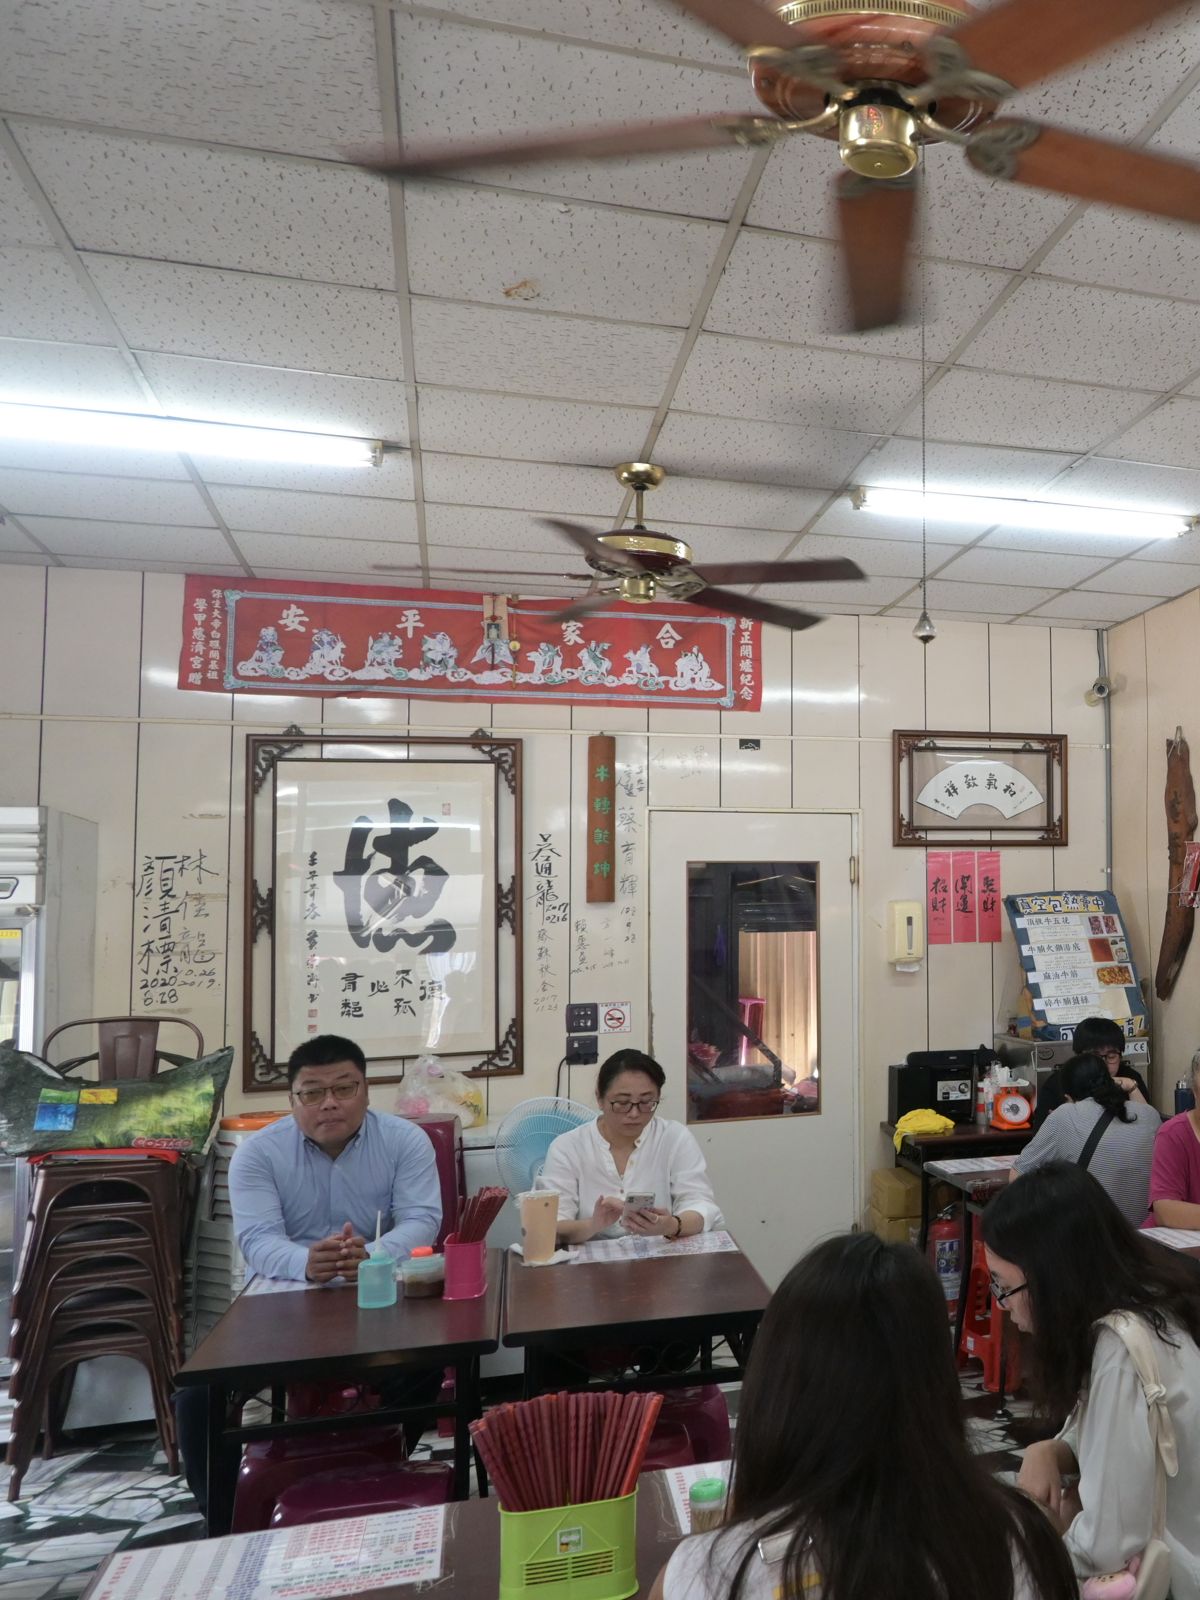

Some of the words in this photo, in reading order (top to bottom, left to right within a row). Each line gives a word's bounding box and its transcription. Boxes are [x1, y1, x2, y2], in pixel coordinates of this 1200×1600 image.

[930, 876, 949, 913] 招財
[1016, 893, 1104, 914] 真空包熱賣中
[136, 855, 179, 975] 顏清標
[140, 976, 178, 990] 2020
